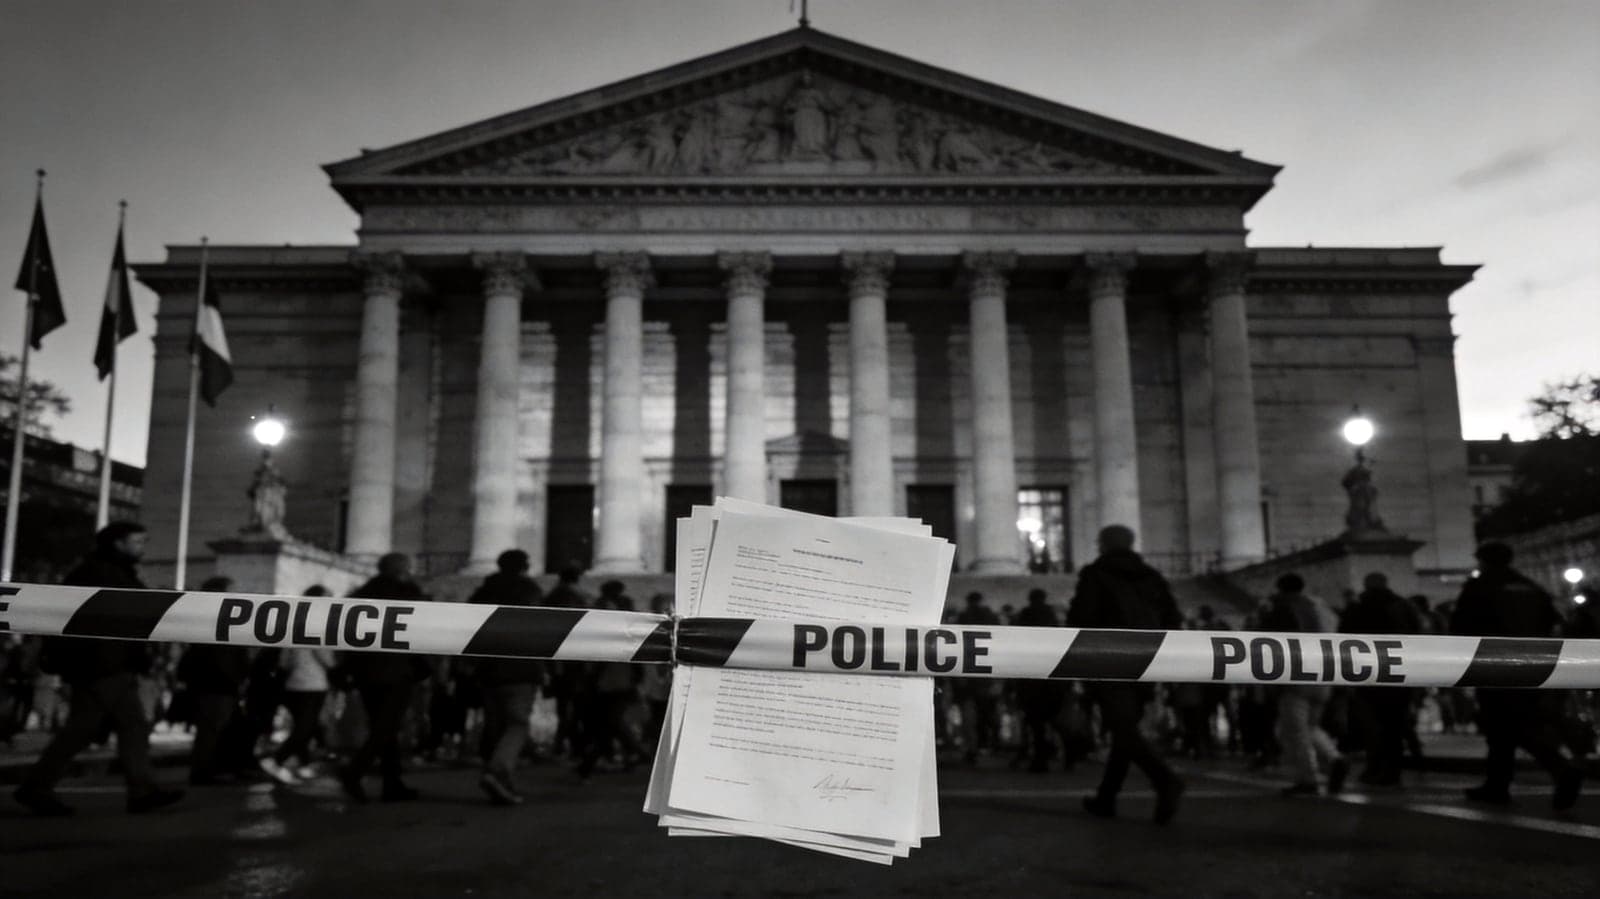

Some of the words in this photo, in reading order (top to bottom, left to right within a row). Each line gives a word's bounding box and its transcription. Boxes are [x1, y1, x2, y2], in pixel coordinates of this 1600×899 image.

[215, 598, 415, 650] POLICE
[792, 624, 992, 674] POLICE
[1210, 637, 1406, 683] POLICE
